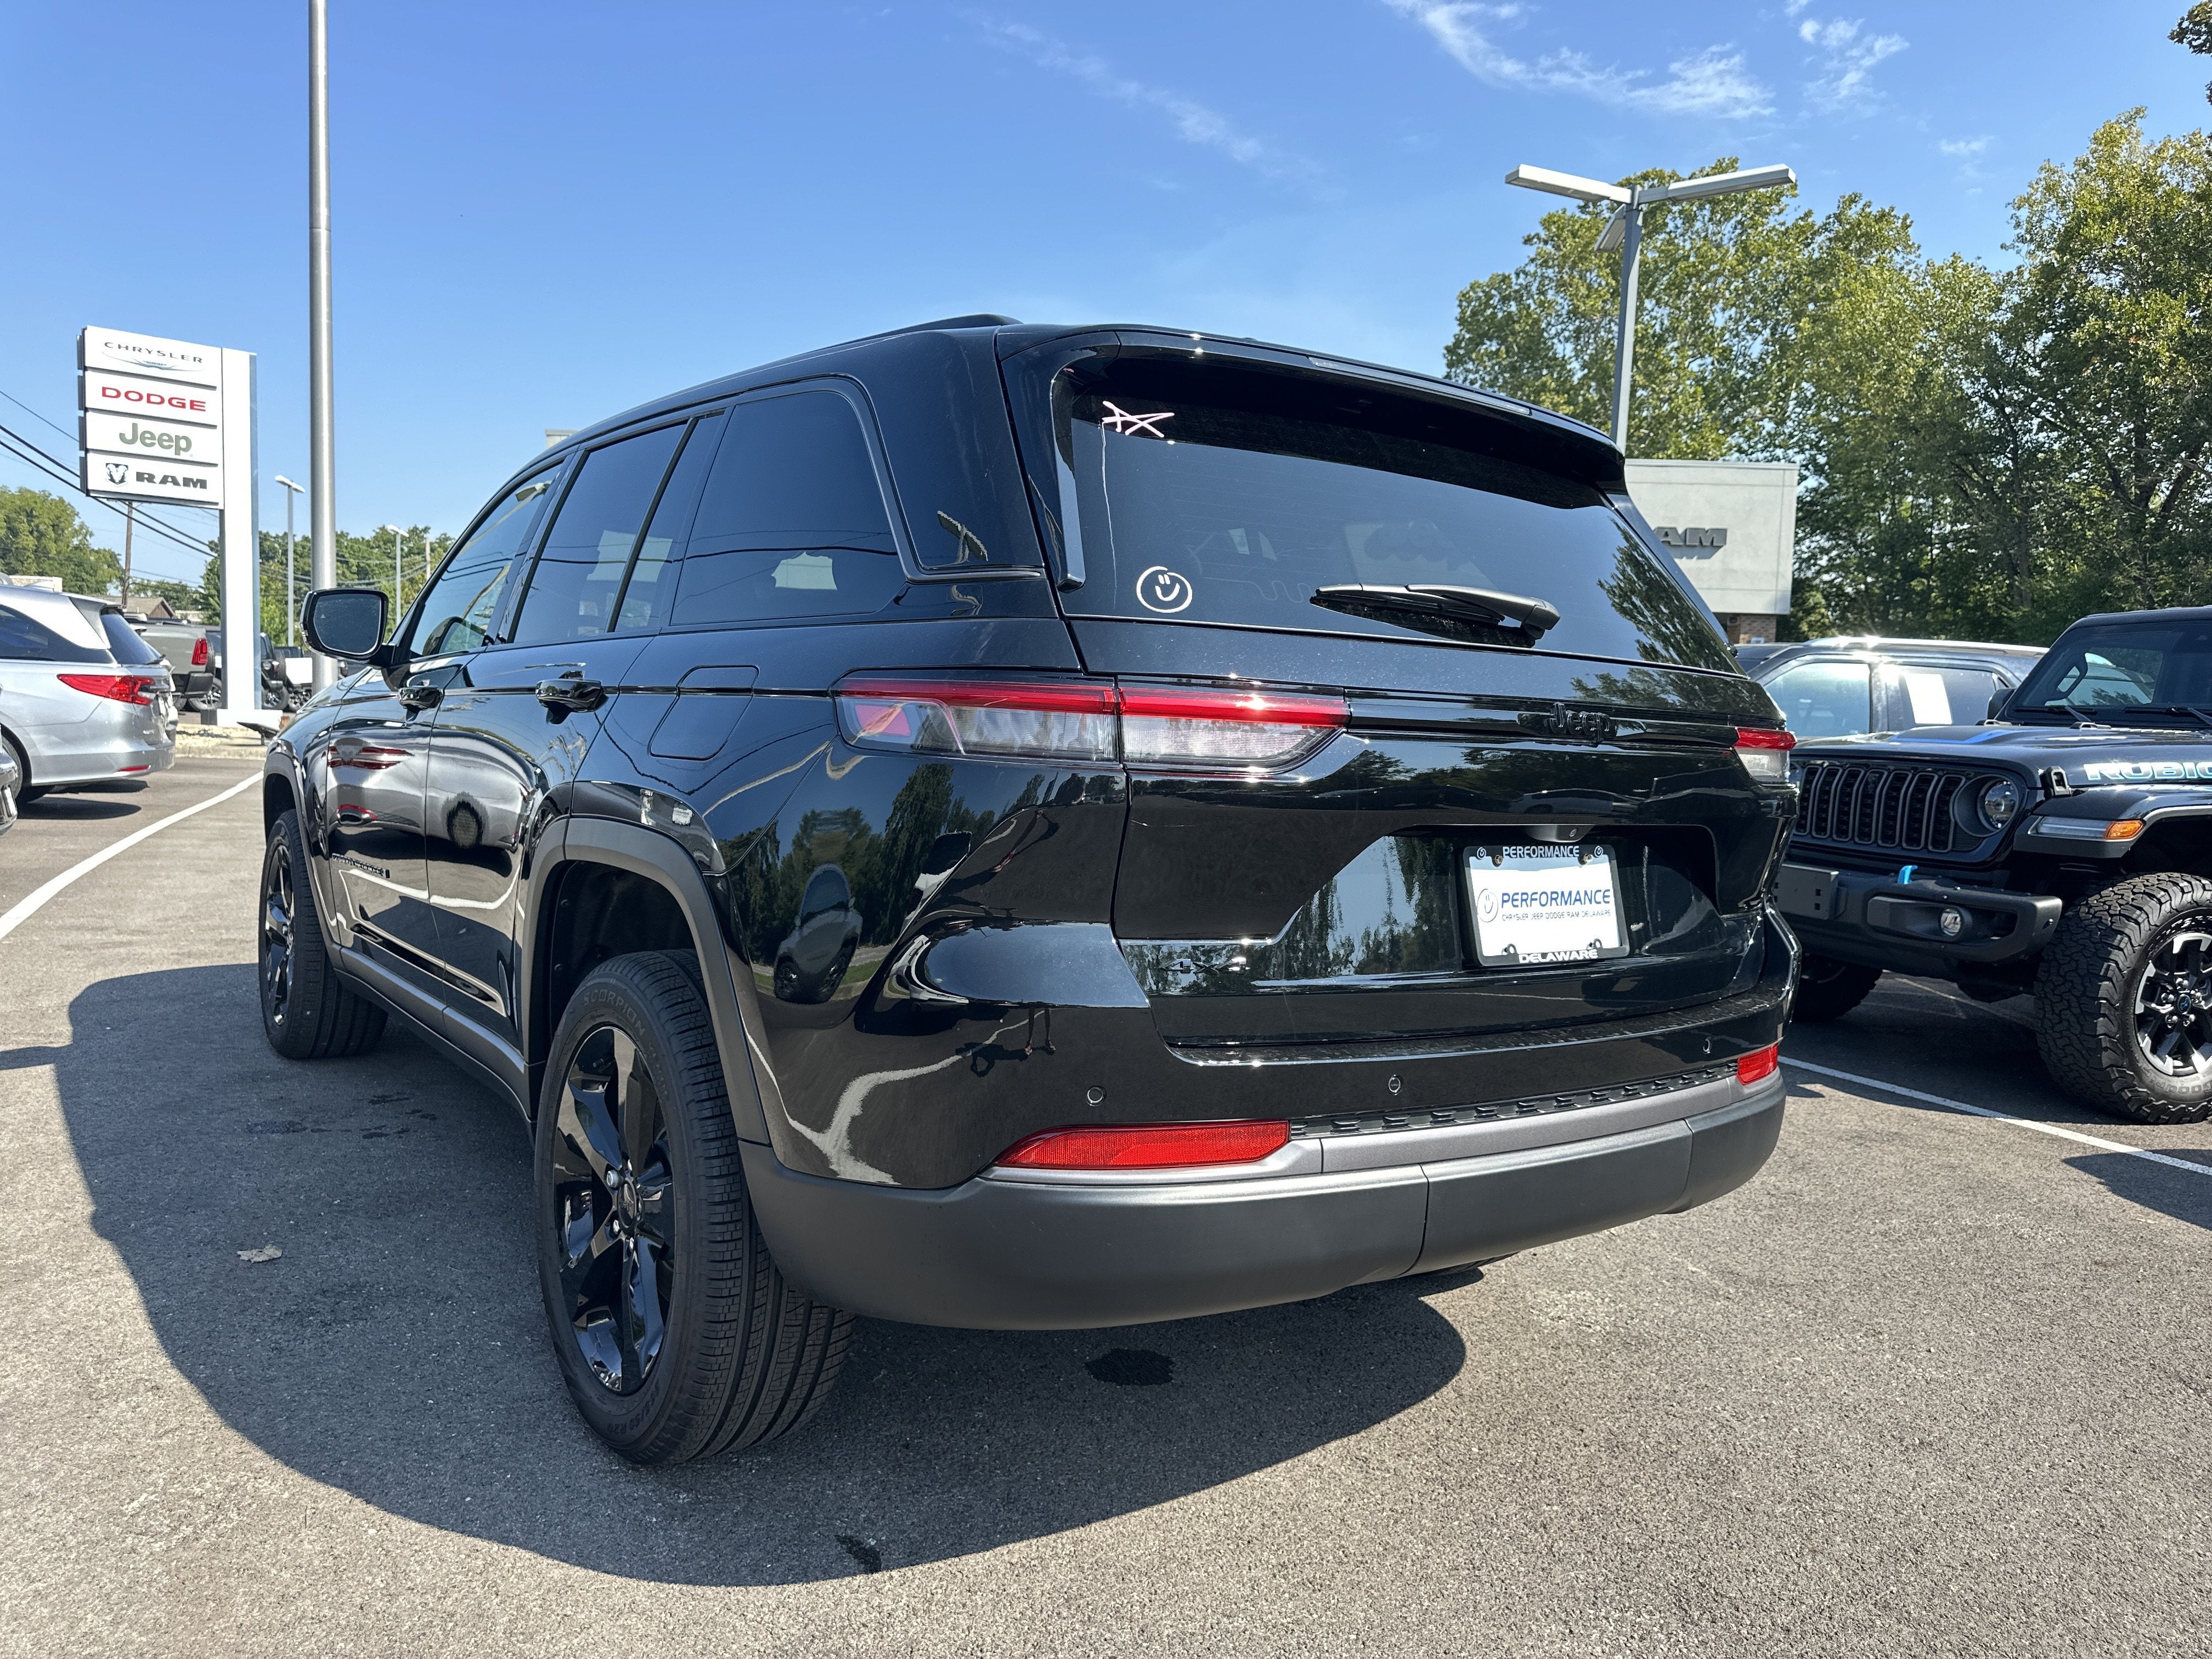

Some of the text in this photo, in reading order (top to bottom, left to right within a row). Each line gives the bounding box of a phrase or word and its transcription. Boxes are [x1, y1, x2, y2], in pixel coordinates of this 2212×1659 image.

[104, 342, 202, 363] CHRYSLER
[101, 386, 206, 412] DODGE
[119, 422, 192, 456] Jeep
[136, 471, 207, 490] RAM
[1653, 526, 1728, 546] AM
[1543, 702, 1611, 742] Jeep
[1502, 845, 1580, 858] PERFORMANCE
[1501, 889, 1611, 909] PERFORMANCE
[1502, 913, 1528, 921] CHRYSLER
[1582, 909, 1611, 917] DELAWARE
[1518, 949, 1599, 964] DELAWARE
[584, 989, 646, 1036] SCORPION
